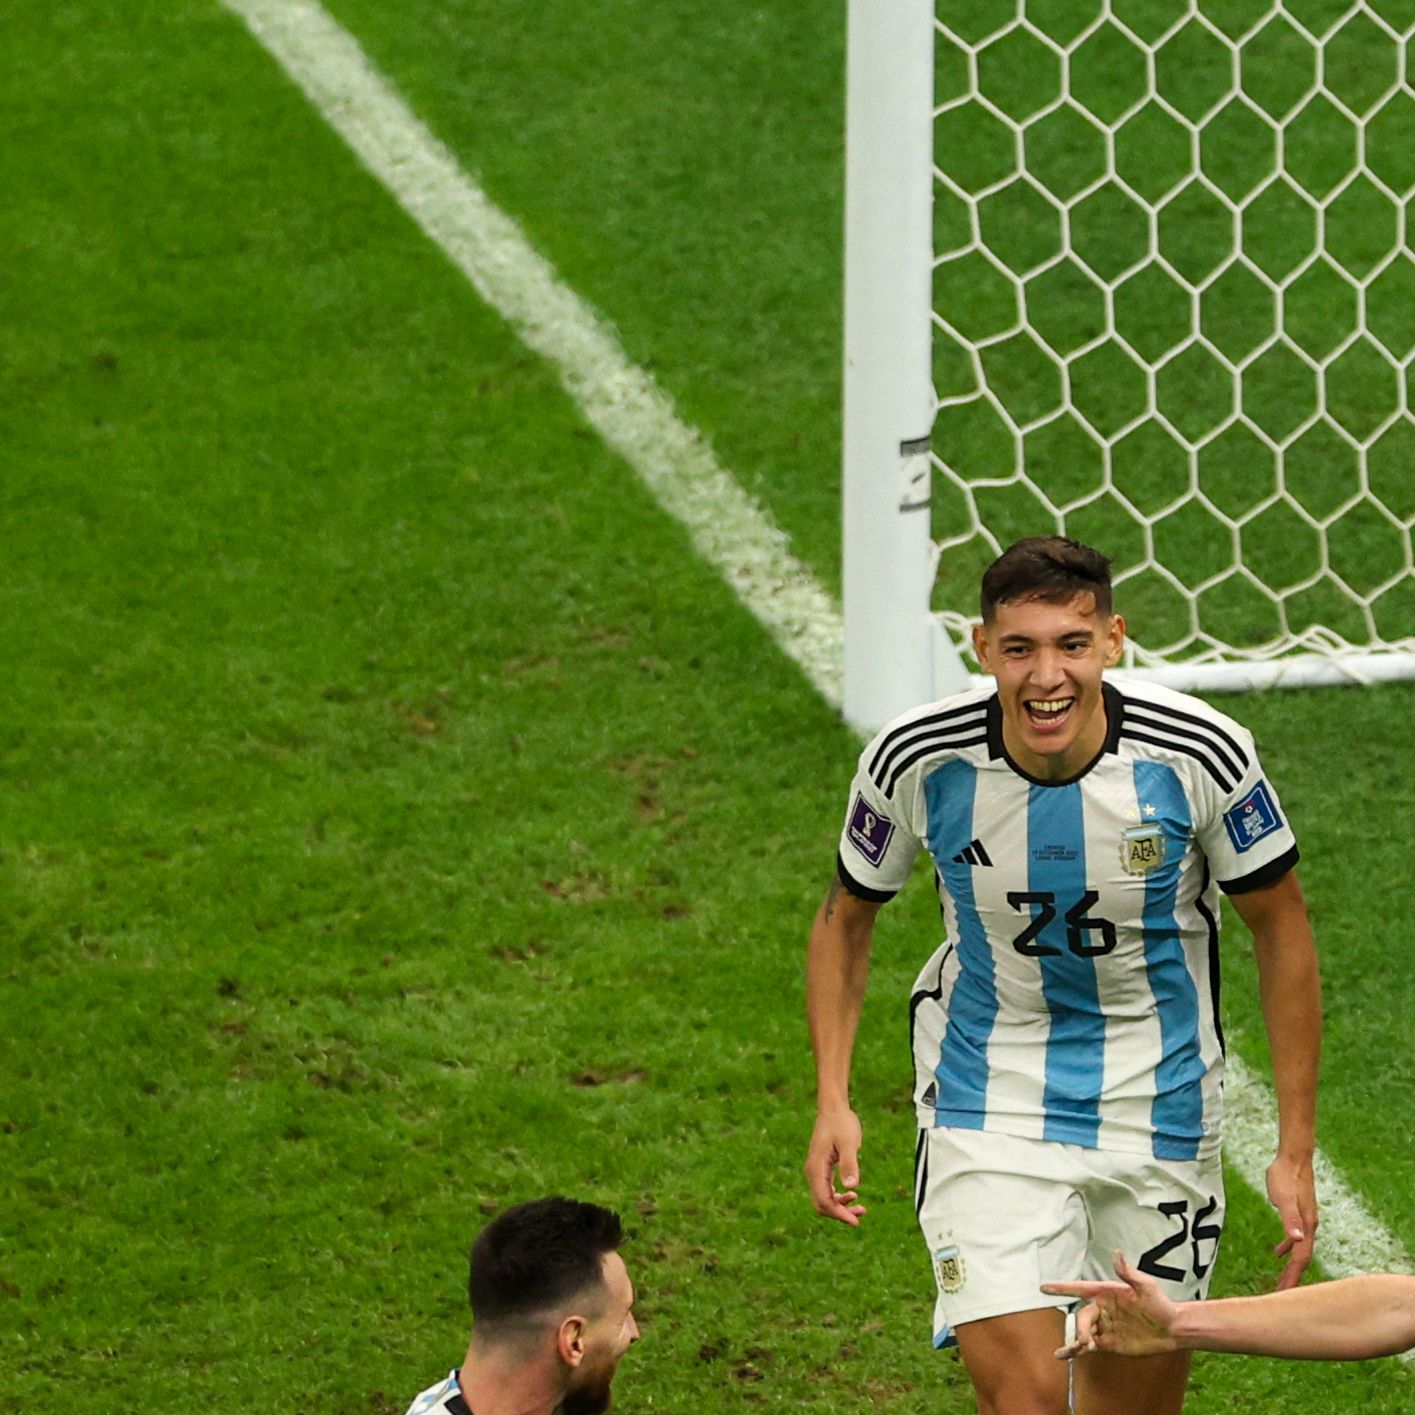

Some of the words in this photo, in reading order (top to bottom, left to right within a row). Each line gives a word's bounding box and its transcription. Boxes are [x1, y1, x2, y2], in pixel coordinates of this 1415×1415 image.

[1131, 838, 1157, 861] AFA
[1006, 890, 1118, 958] 26
[1137, 1195, 1221, 1283] 26
